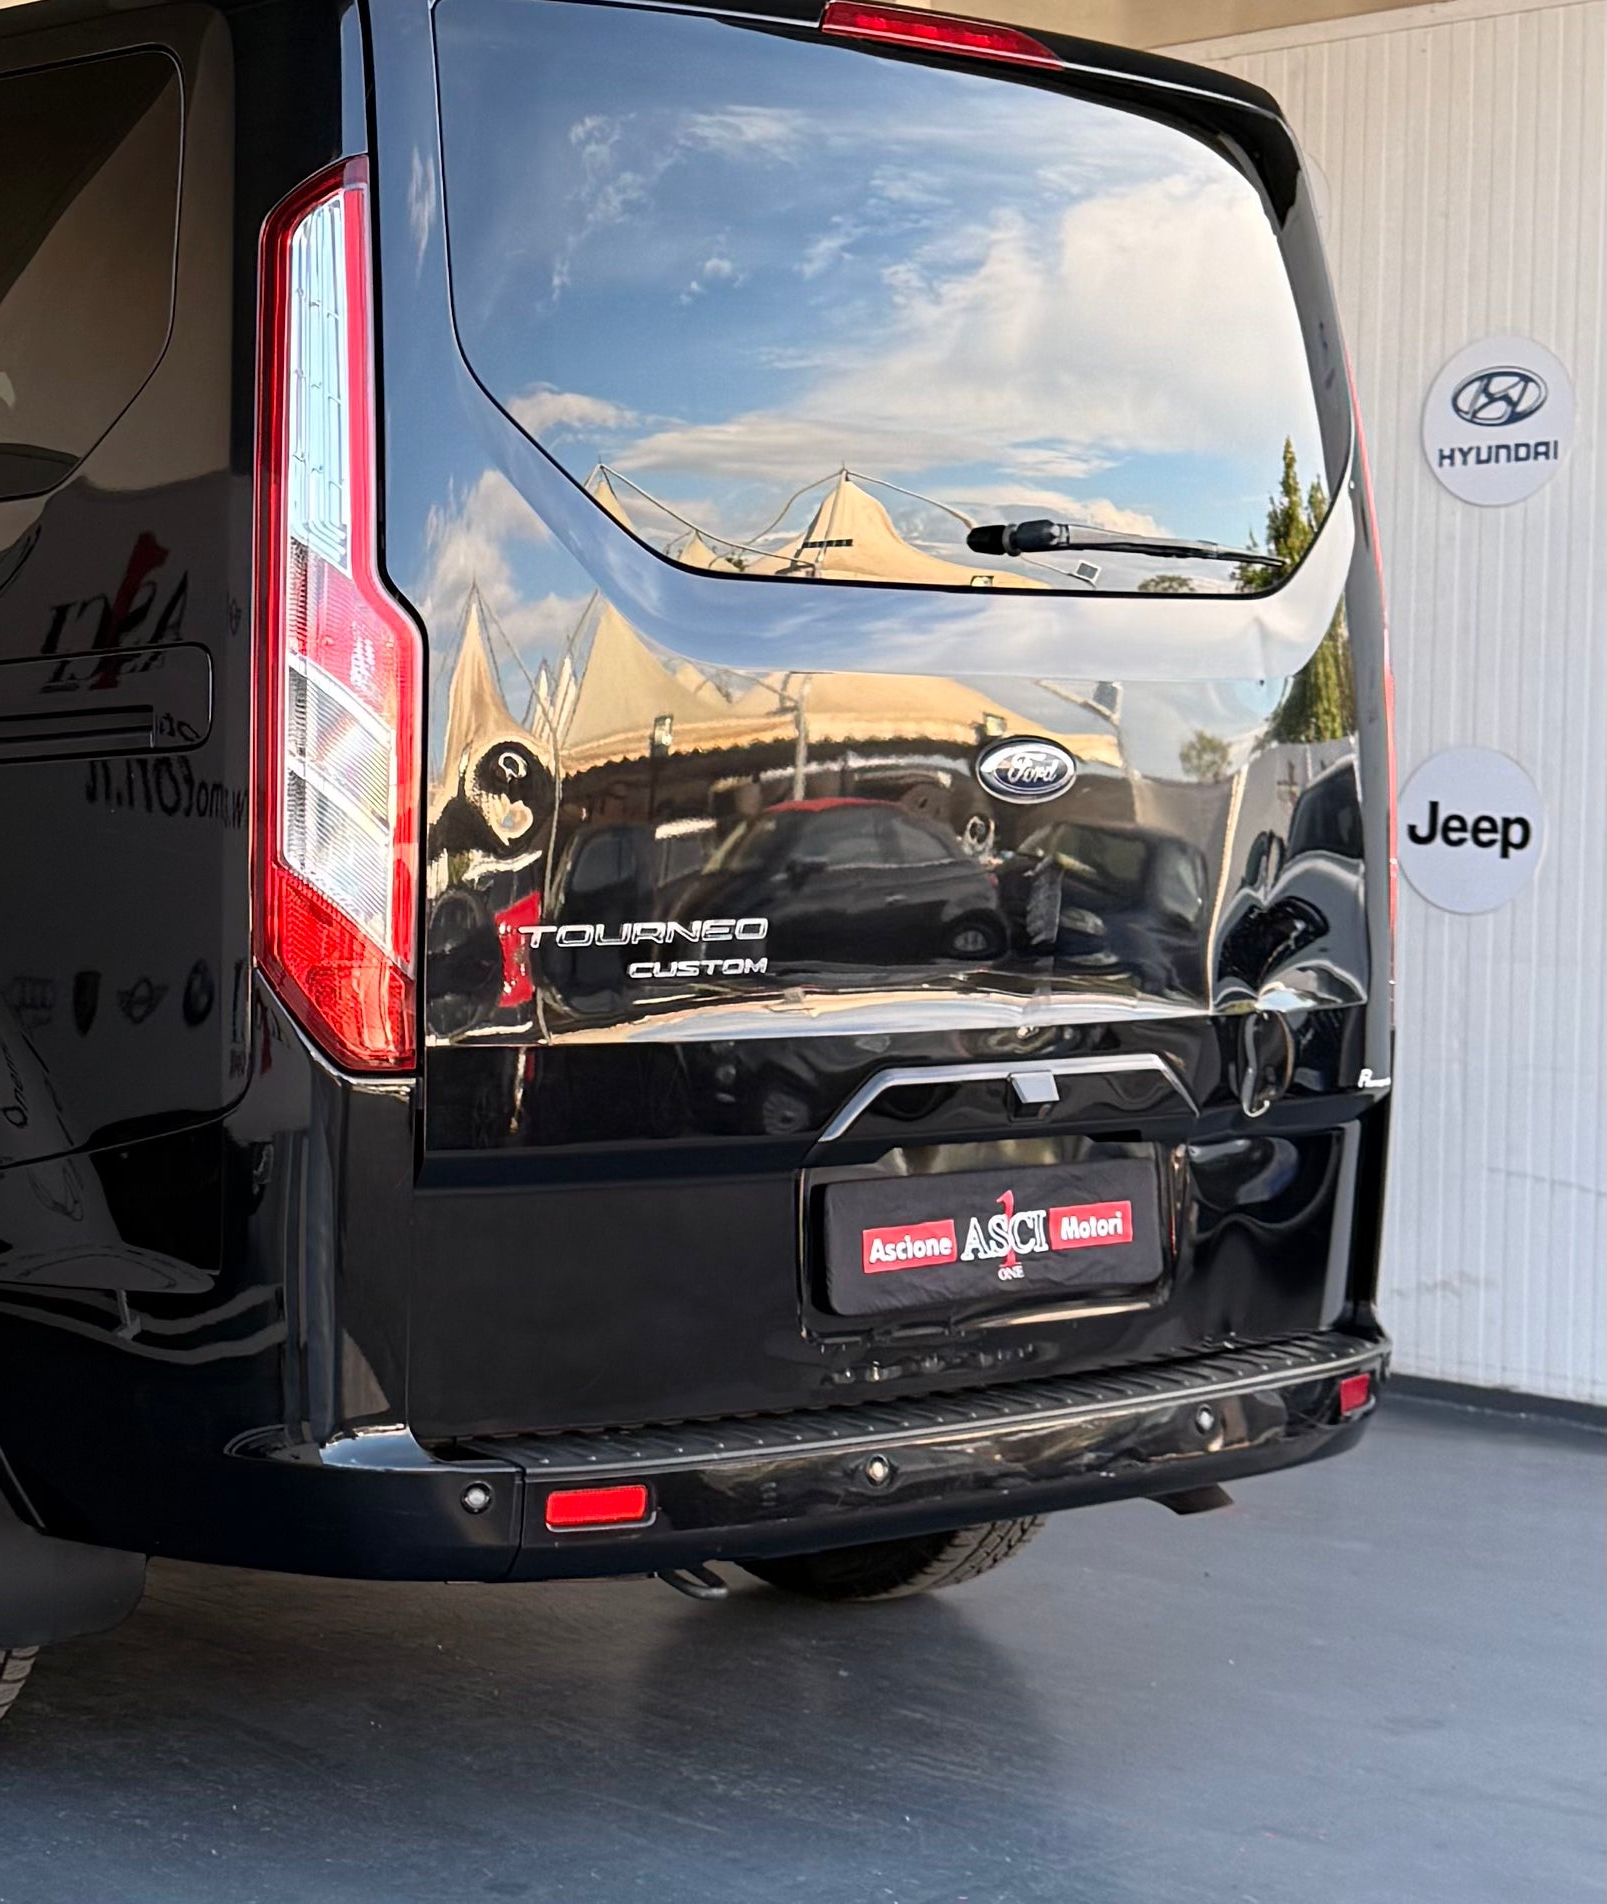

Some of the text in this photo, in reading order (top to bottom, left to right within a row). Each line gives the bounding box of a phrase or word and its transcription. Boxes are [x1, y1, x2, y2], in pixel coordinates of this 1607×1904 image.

[1438, 439, 1559, 468] HYUNDAI
[1007, 751, 1060, 784] Ford
[1407, 800, 1532, 858] Jeep
[517, 916, 769, 950] TOURNEO
[628, 957, 768, 980] CUSTOM
[869, 1210, 1124, 1264] Ascione ASCI Motori
[997, 1265, 1025, 1281] ONE
